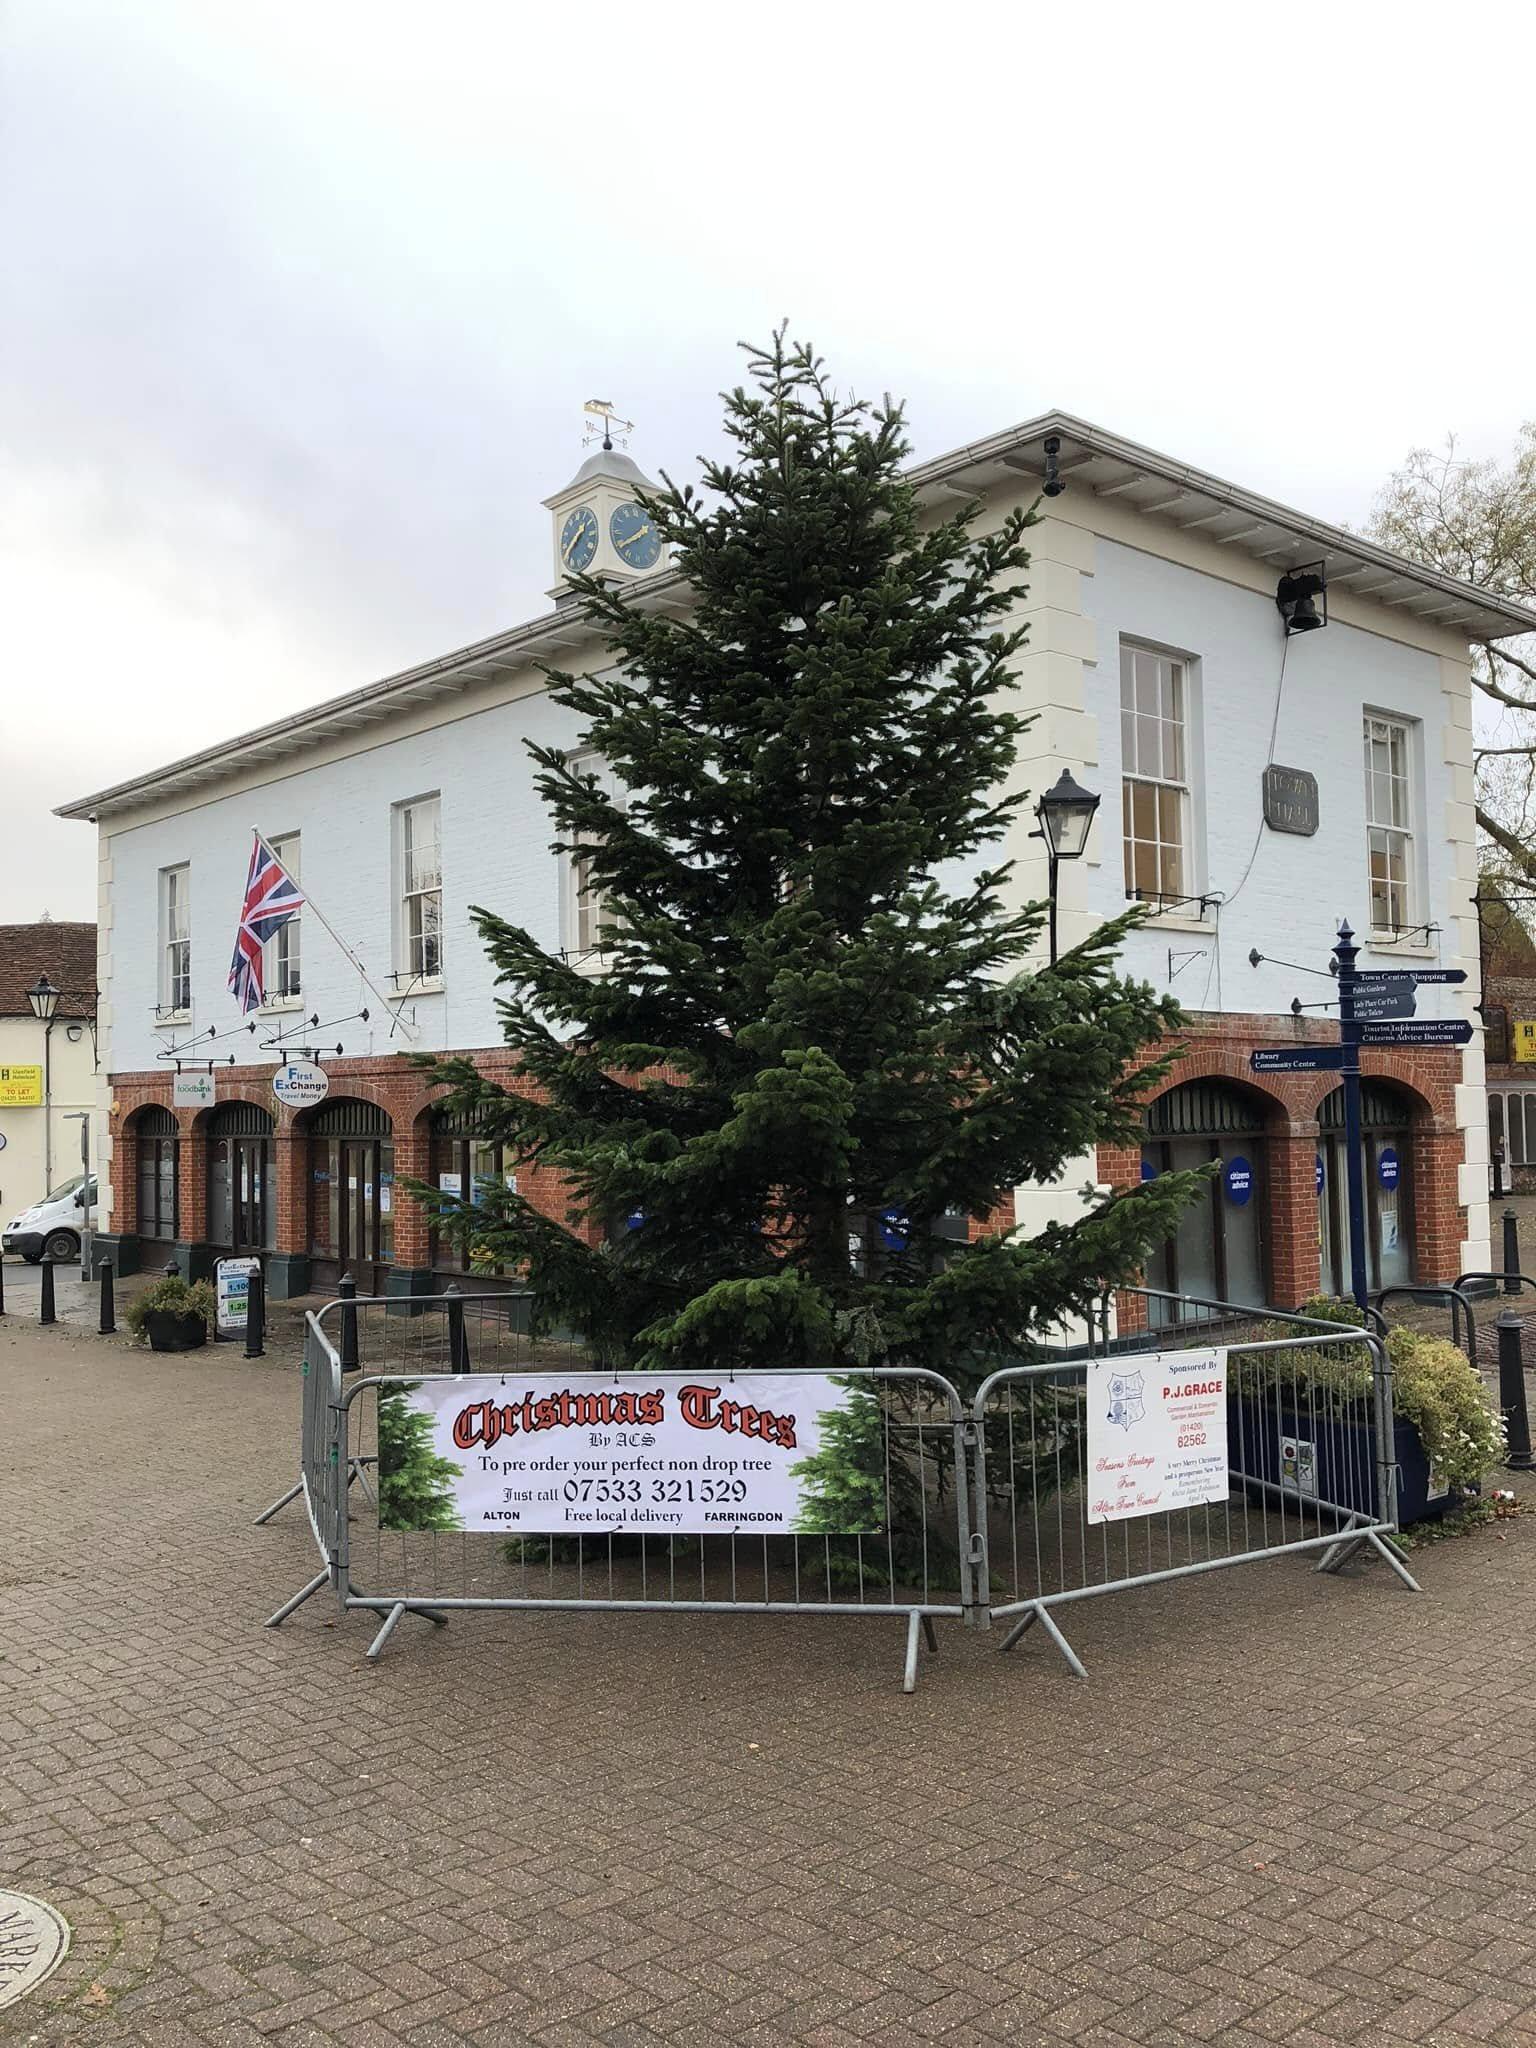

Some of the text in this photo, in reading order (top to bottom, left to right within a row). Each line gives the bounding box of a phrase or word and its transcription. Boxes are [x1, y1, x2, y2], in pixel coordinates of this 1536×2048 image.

[1360, 973, 1381, 981] Town
[1410, 973, 1447, 982] Shopping
[1363, 1023, 1466, 1034] Tourist Information Centre
[1255, 1061, 1292, 1069] Community
[288, 1067, 313, 1080] First
[177, 1084, 212, 1093] foodbank
[275, 1079, 327, 1091] ExChange
[300, 1092, 322, 1100] Money
[1230, 1172, 1249, 1180] citizens
[1232, 1181, 1248, 1189] advice
[1169, 1360, 1217, 1375] Sponsored By
[1163, 1380, 1222, 1399] P.J.GRACE
[453, 1385, 797, 1450] Christmas Trees
[588, 1432, 656, 1448] By ACS
[1177, 1432, 1207, 1448] 82562
[478, 1455, 772, 1476] To pre order your perfect non drop tree
[503, 1479, 747, 1503] Just call 07533 321529
[483, 1511, 520, 1521] ALTON
[565, 1507, 683, 1526] Free local delivery
[704, 1512, 783, 1522] FARRINGDON
